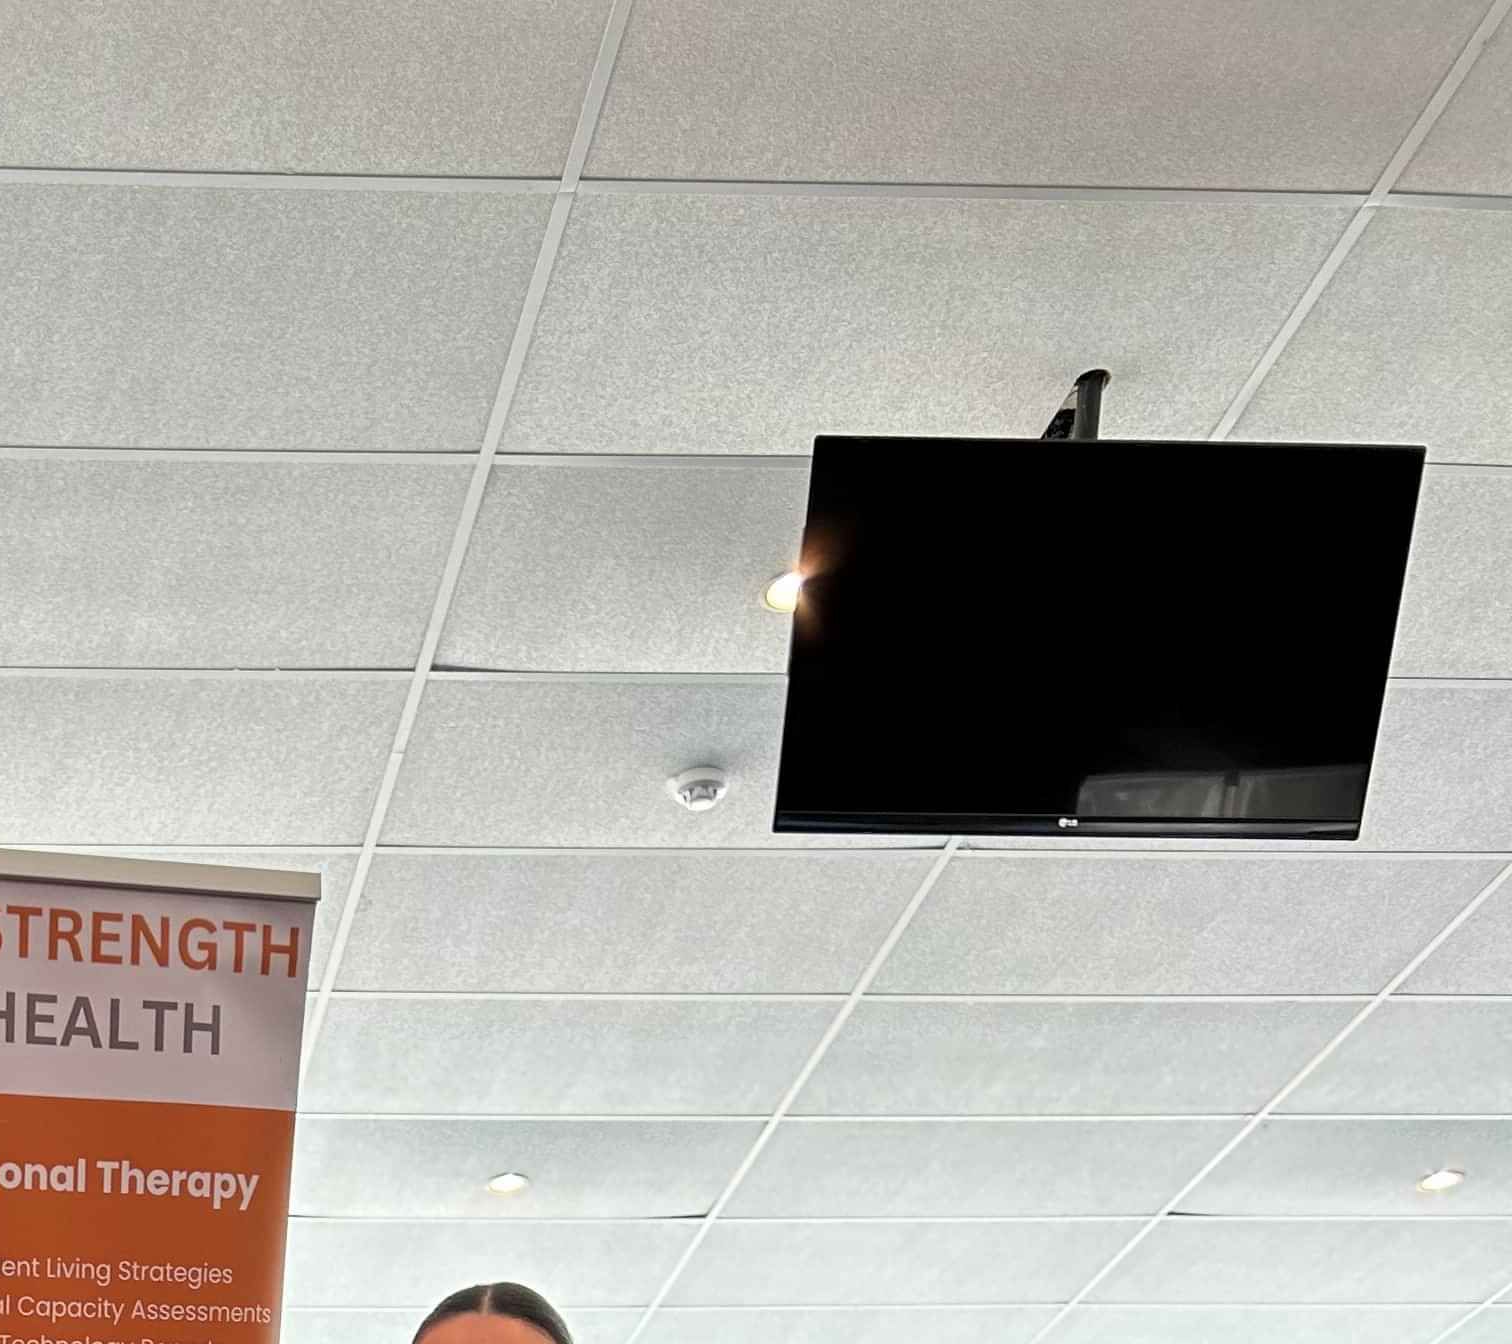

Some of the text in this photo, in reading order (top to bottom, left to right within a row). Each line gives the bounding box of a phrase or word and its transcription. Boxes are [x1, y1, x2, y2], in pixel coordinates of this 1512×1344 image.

[96, 1160, 260, 1211] Therapy
[46, 1257, 112, 1287] Living
[117, 1261, 233, 1290] Strategies
[17, 1296, 124, 1325] Capacity
[130, 1302, 272, 1325] Assessments
